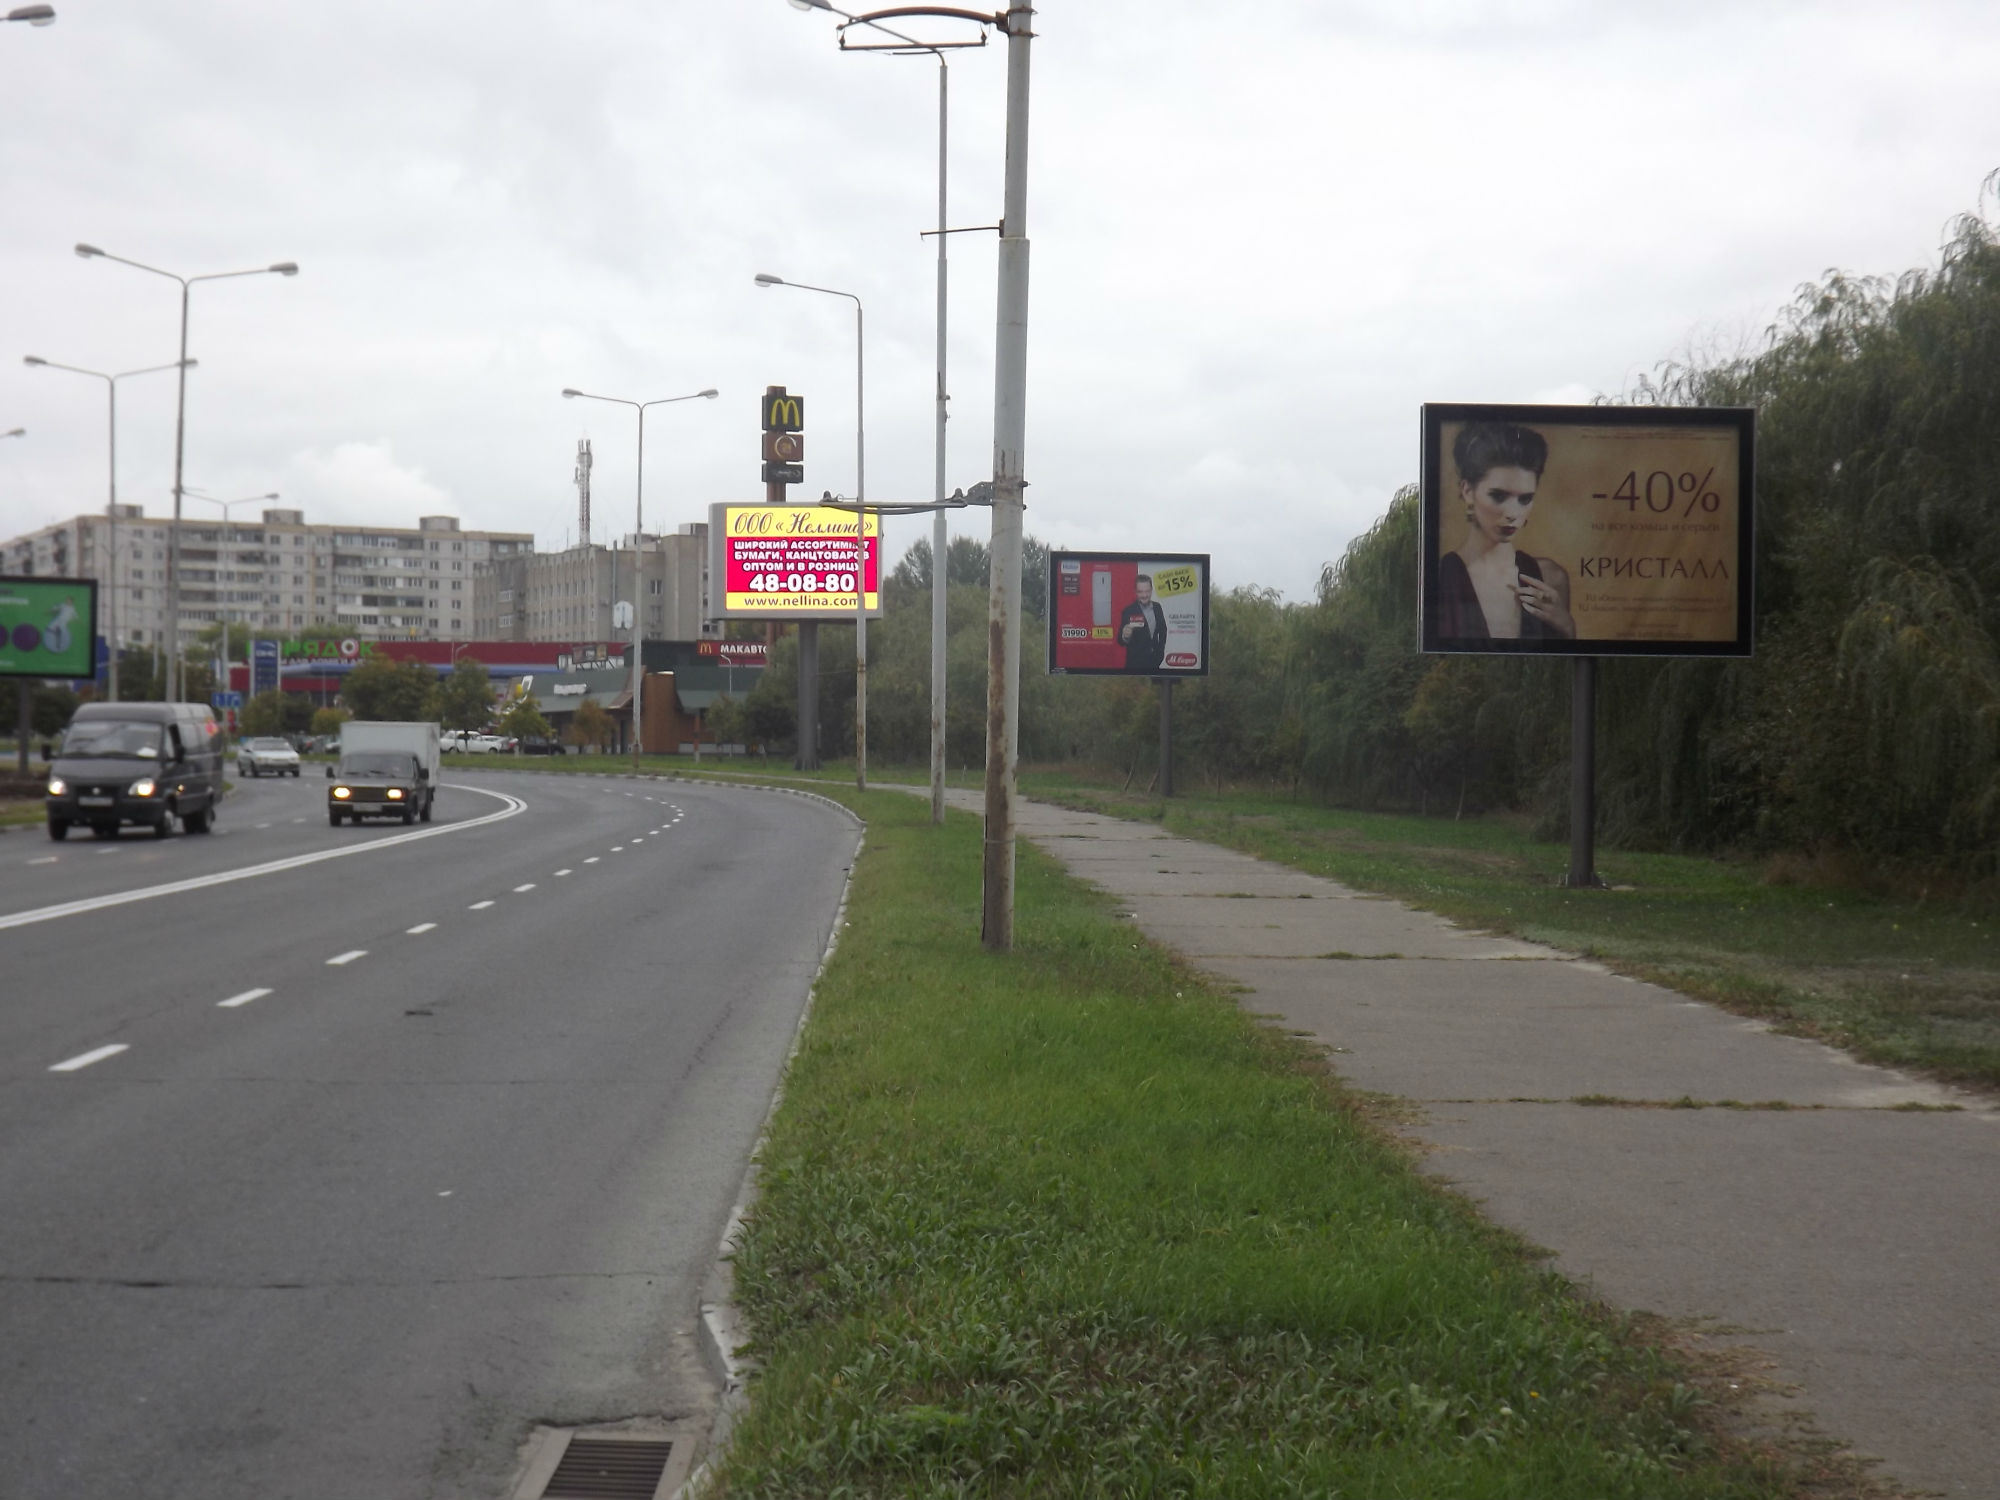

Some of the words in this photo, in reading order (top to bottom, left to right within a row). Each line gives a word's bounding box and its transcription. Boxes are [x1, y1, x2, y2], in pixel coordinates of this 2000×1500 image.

[1592, 467, 1720, 518] -40%
[734, 512, 773, 534] ООО
[734, 539, 788, 550] ШИРОКИЙ
[734, 551, 783, 561] БУМАГИ,
[742, 562, 784, 572] ОПТОМ
[786, 562, 795, 571] И
[798, 562, 805, 571] В
[1580, 557, 1729, 580] КРИСТАЛЛ
[749, 573, 856, 592] 48-08-80
[1165, 575, 1194, 593] 15%
[744, 595, 858, 606] www.nellina.com
